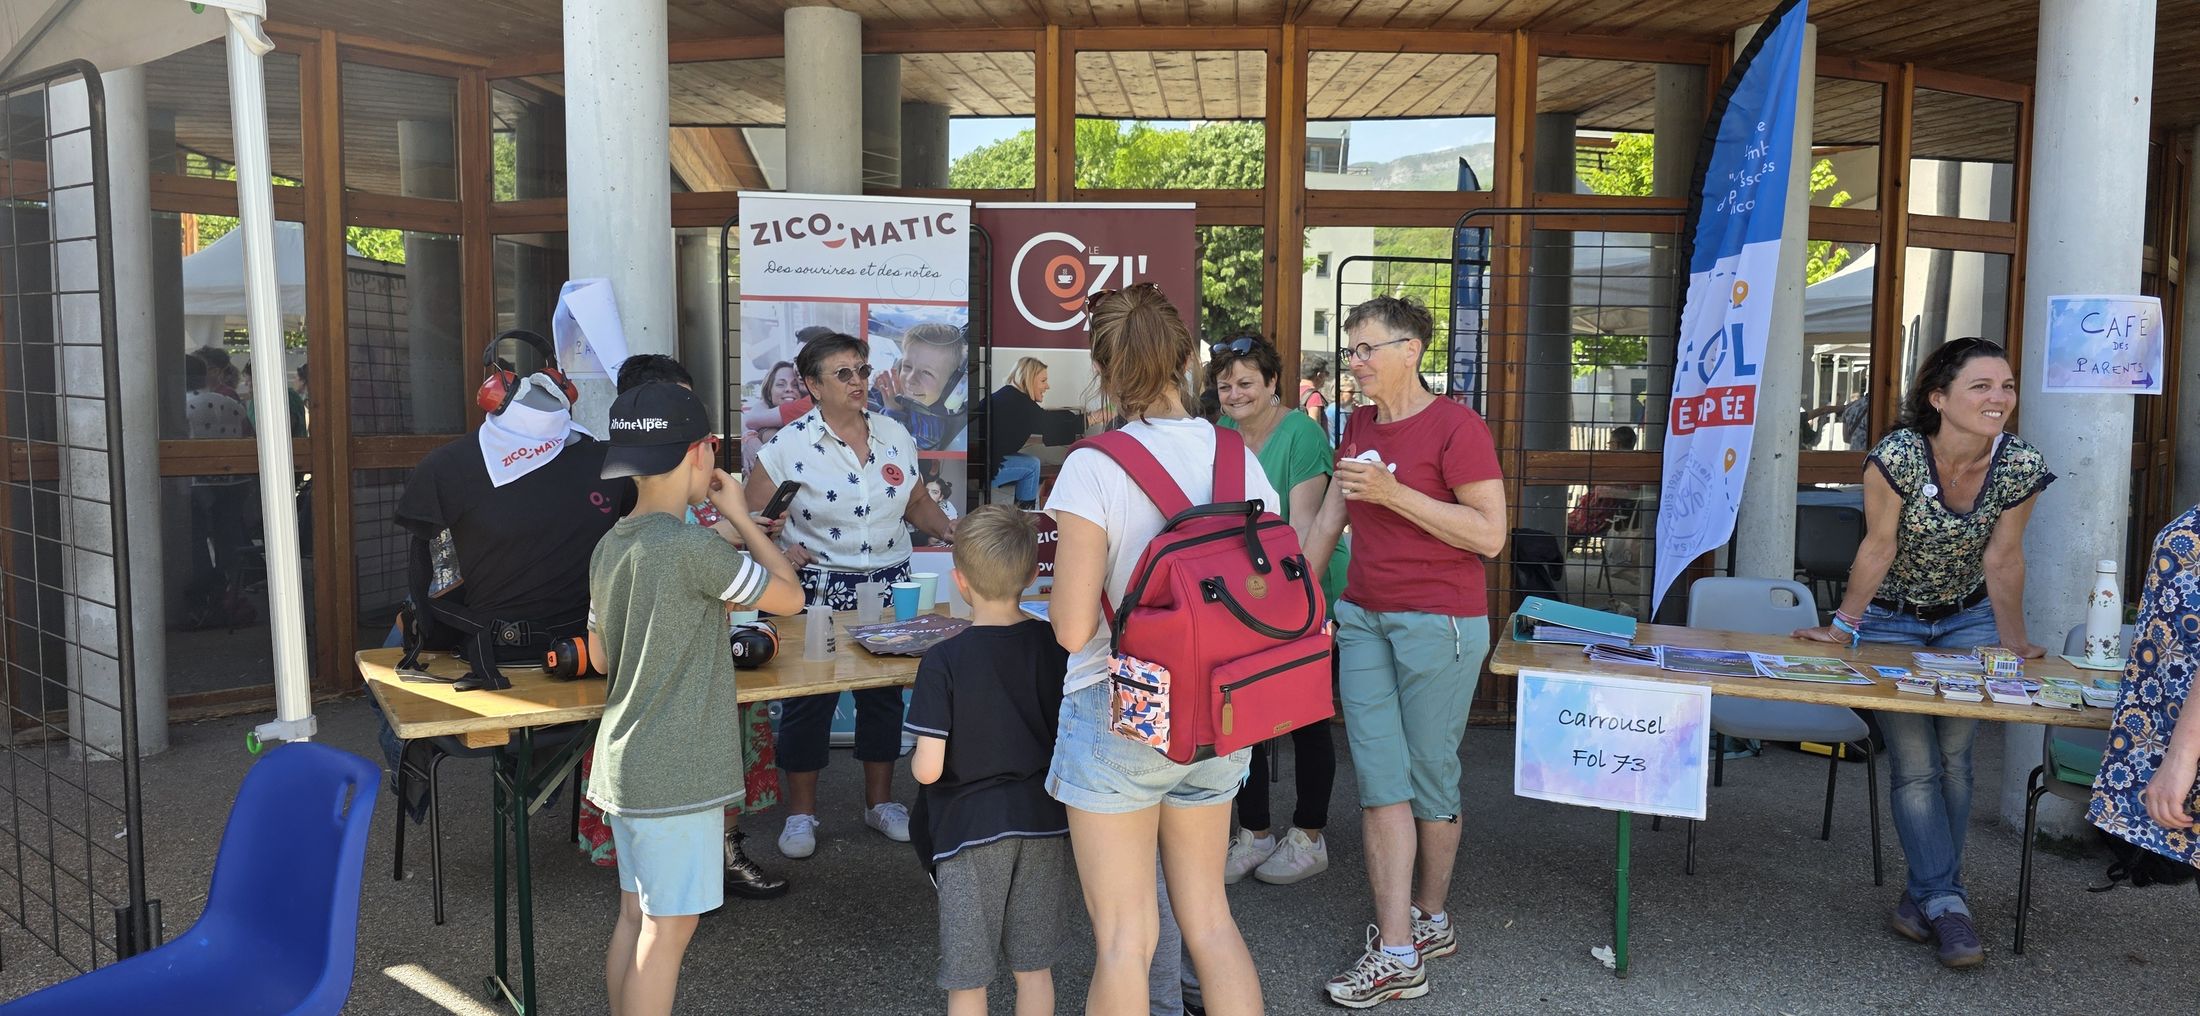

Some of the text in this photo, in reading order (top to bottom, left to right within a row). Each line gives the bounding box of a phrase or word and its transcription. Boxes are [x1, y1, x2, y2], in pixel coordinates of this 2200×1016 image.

[1088, 246, 1100, 255] LE
[764, 260, 941, 278] Des sourires et des notes
[2080, 309, 2149, 338] CAFÉ
[2112, 341, 2129, 351] DES
[2072, 357, 2144, 375] PARENTS
[501, 447, 528, 468] ZICO
[1573, 749, 1647, 774] Fol 73
